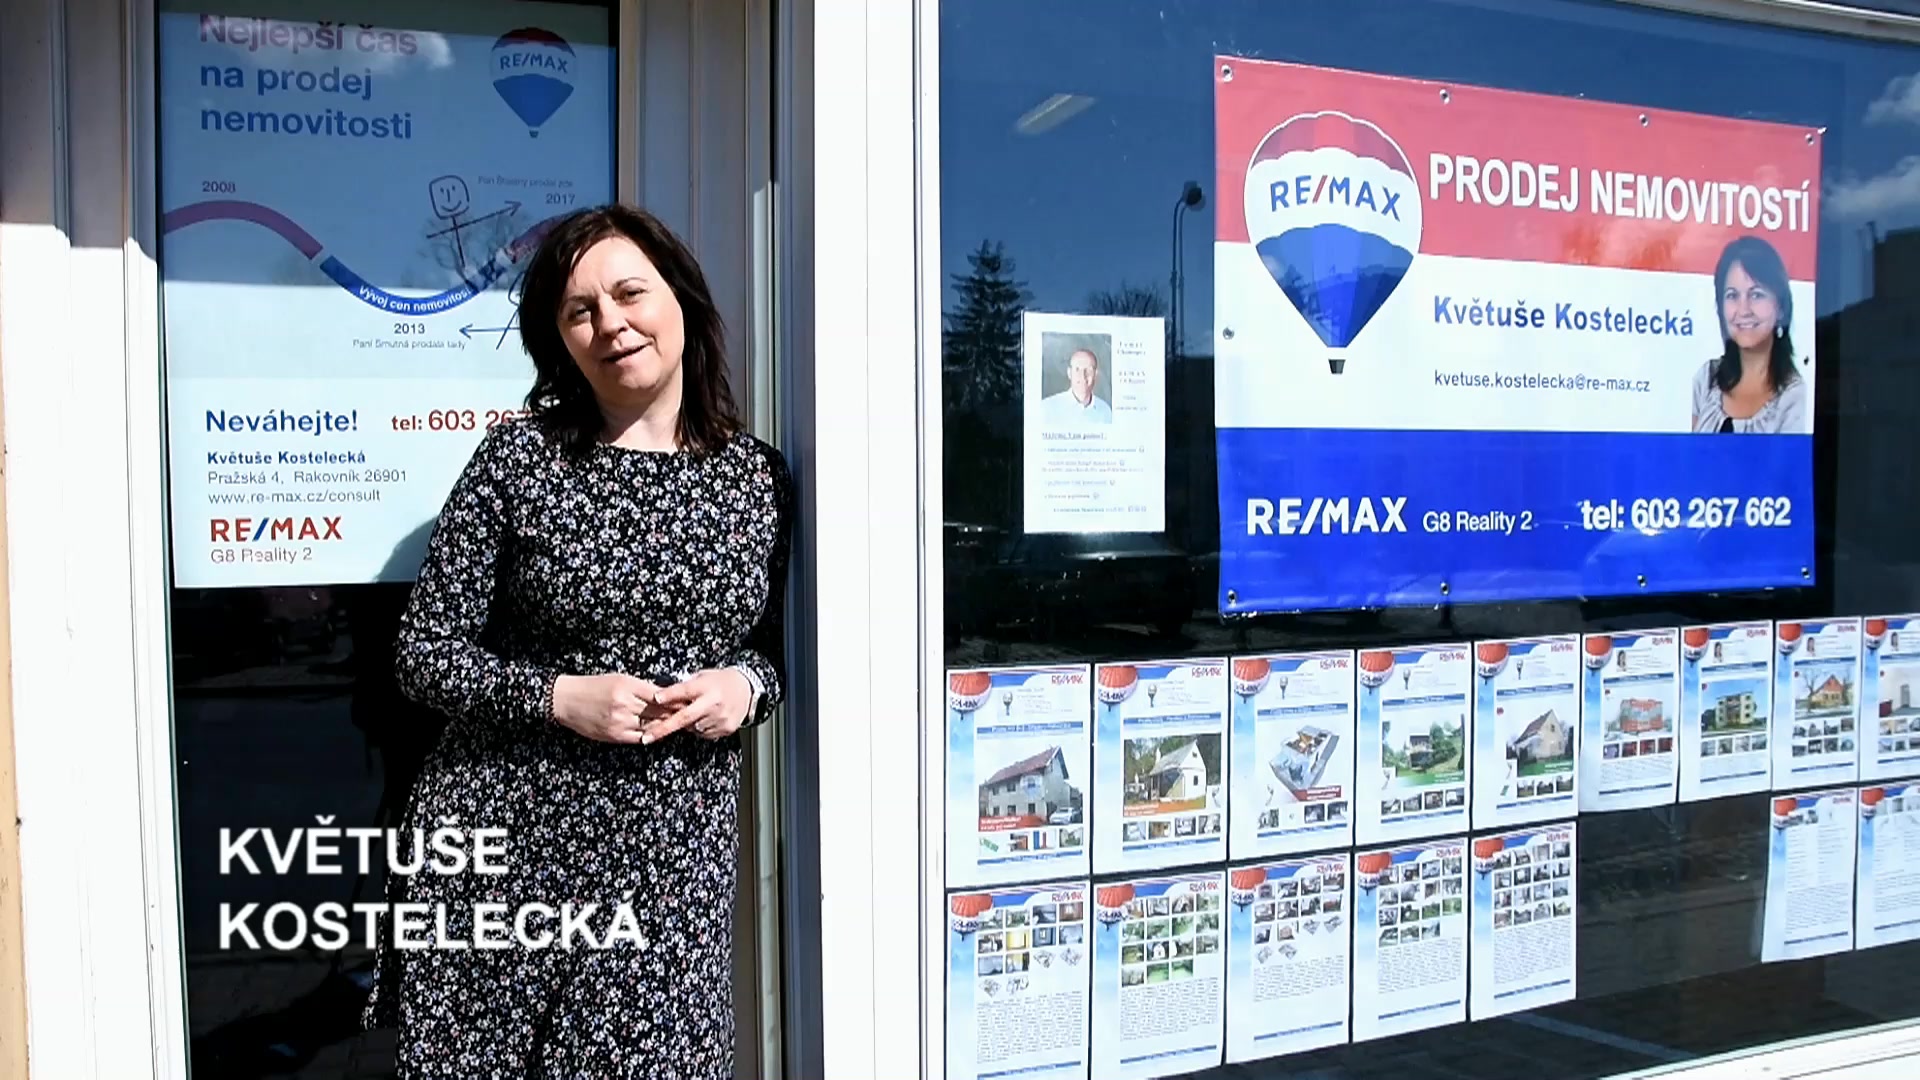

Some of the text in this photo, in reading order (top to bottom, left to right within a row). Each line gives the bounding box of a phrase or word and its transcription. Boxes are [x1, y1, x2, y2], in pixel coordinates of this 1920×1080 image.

[200, 13, 418, 55] Nejlepší čas
[499, 51, 568, 74] RE/MAX
[200, 65, 372, 100] na prodej
[201, 108, 412, 139] nemovitosti
[202, 181, 236, 194] 2008
[545, 193, 576, 205] 2017
[1270, 174, 1401, 222] RE/MAX
[1429, 152, 1811, 233] PRODEJ NEMOVITOSTÍ
[359, 285, 389, 309] Vývoj
[413, 286, 472, 313] nemovitost
[1434, 295, 1693, 337] Květuše Kostelecká
[393, 323, 426, 335] 2013
[1434, 369, 1651, 393] kvetuse.kostelecka@re-max.cz
[205, 409, 358, 437] Neváhejte!
[391, 415, 423, 431] tel:
[428, 409, 476, 431] 603
[207, 450, 366, 465] Květuše Kostelecká
[208, 469, 407, 486] Pražská 4, Rakovník 26901
[208, 489, 381, 505] www.re-max.cz/consult
[1246, 496, 1408, 536] RE/MAX
[1422, 511, 1533, 535] G8 Reality 2
[1581, 496, 1792, 530] tel: 603 267 662
[210, 516, 343, 543] RE/MAX
[210, 547, 313, 565] G8 Reality 2
